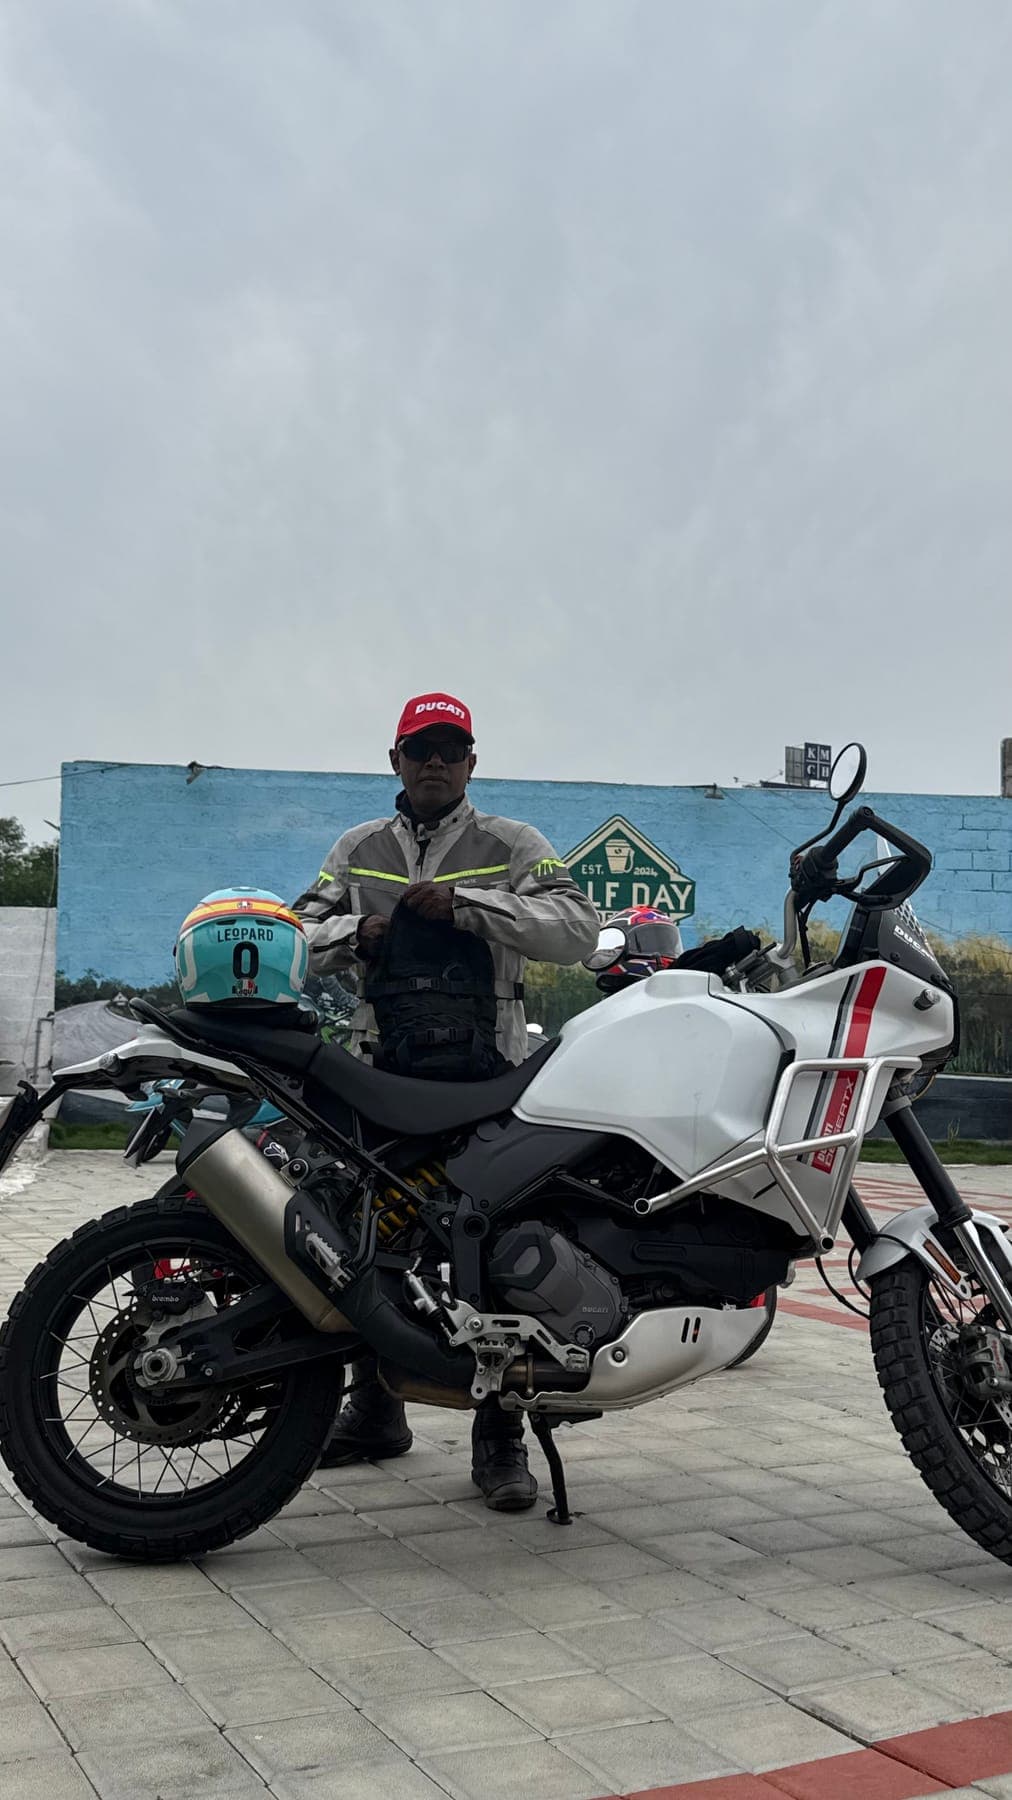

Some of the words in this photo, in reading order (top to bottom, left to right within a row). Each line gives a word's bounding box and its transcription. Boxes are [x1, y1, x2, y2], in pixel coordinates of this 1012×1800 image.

[415, 701, 465, 720] DUCATI
[581, 864, 604, 875] EST.
[587, 880, 620, 908] LF
[631, 882, 693, 911] DAY
[217, 927, 274, 942] LEOPARD
[233, 941, 259, 979] 0
[152, 1294, 180, 1302] brembo
